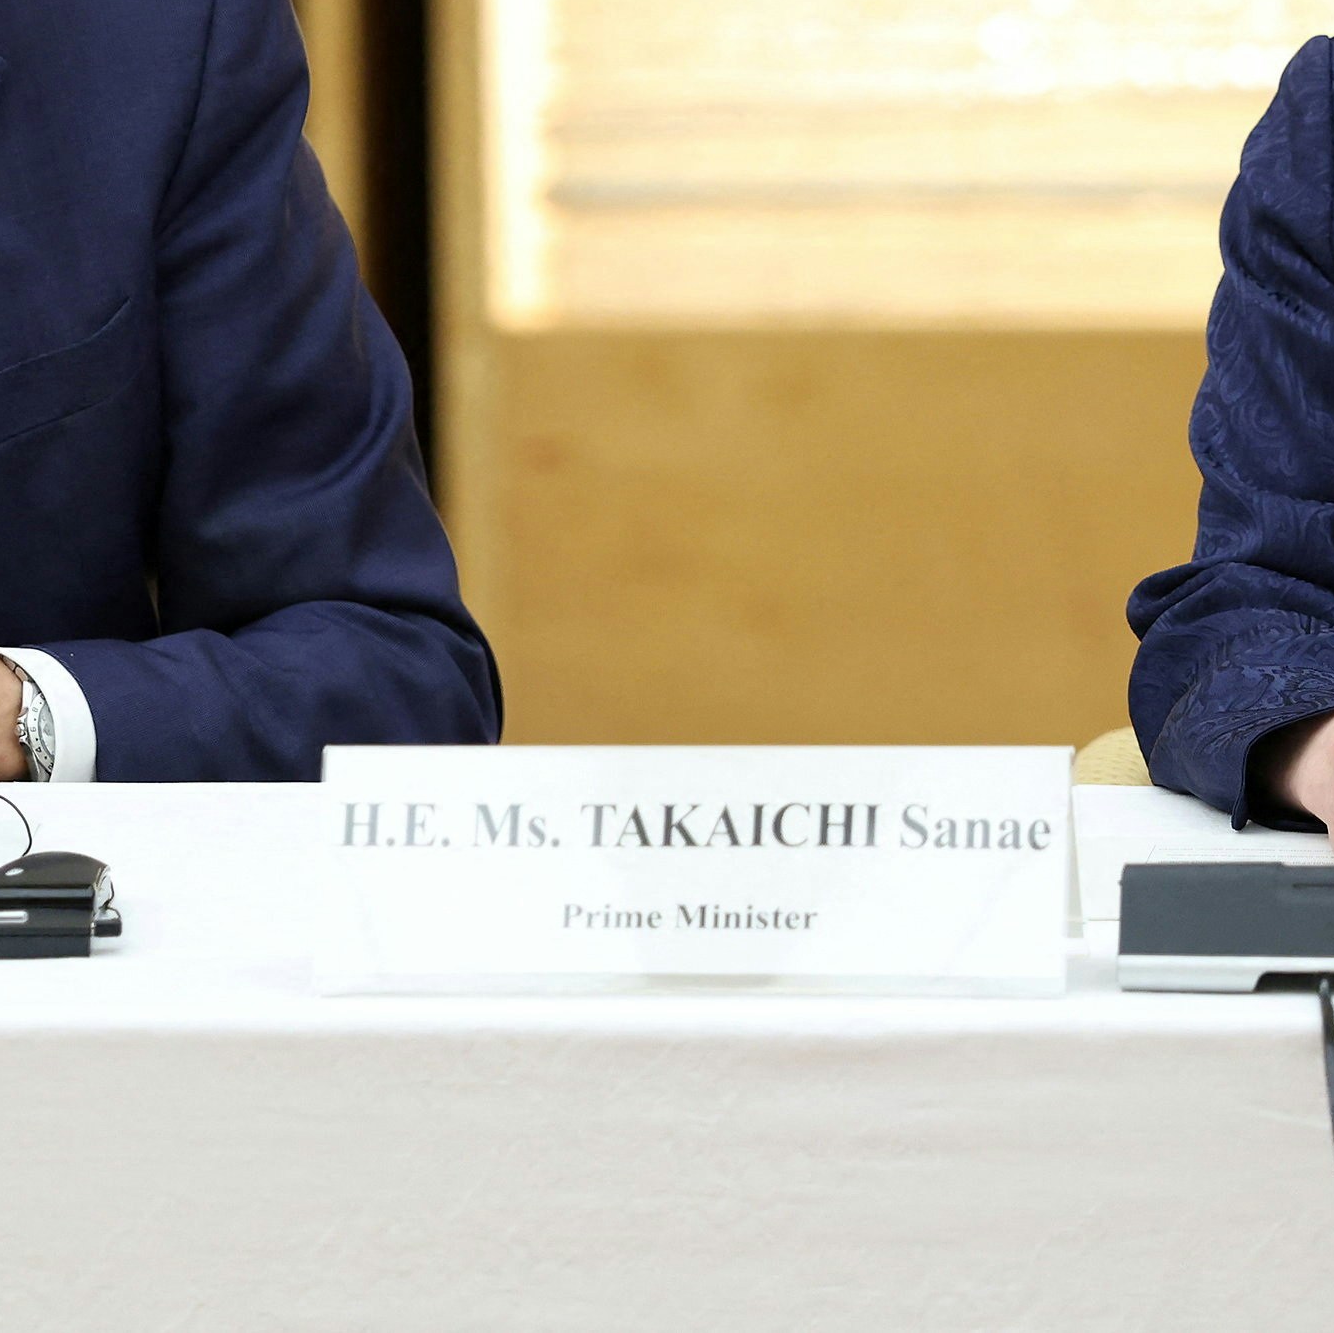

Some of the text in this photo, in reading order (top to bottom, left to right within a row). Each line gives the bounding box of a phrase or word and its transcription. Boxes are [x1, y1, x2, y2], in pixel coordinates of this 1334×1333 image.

[340, 801, 1053, 852] H.E. Ms. TAKAICHI Sanae
[561, 903, 819, 930] Prime Minister
